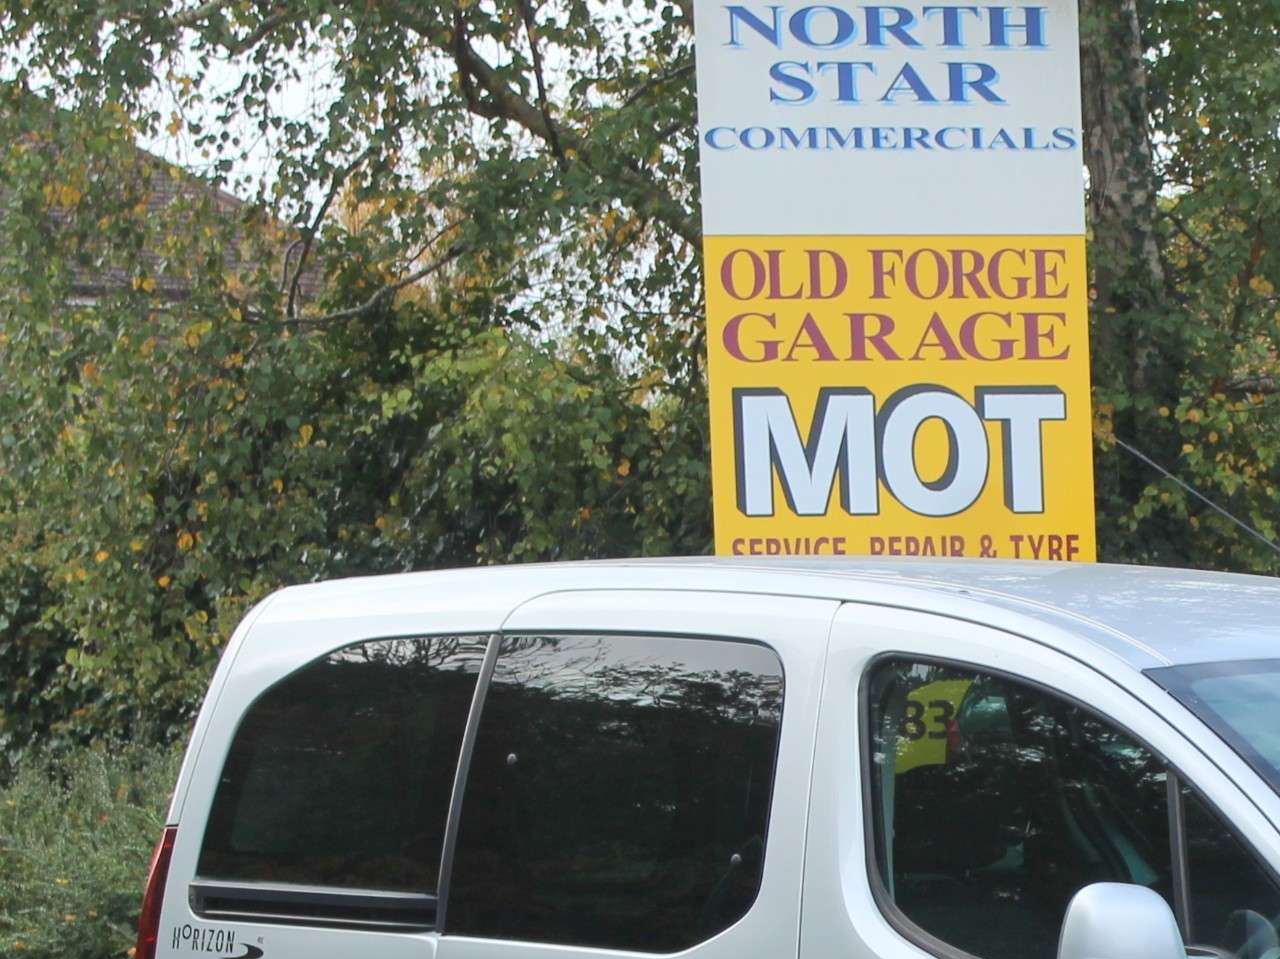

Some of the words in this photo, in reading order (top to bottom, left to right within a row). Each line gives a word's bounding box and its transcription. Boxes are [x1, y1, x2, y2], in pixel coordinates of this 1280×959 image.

[723, 5, 1048, 49] NORTH
[769, 60, 1008, 105] STAR
[704, 126, 1077, 152] COMMERCIALS
[720, 248, 848, 300] OLD
[867, 248, 1069, 300] FORGE
[722, 311, 1071, 363] GARAGE
[731, 383, 1067, 518] MOT
[1009, 534, 1079, 561] TYRE
